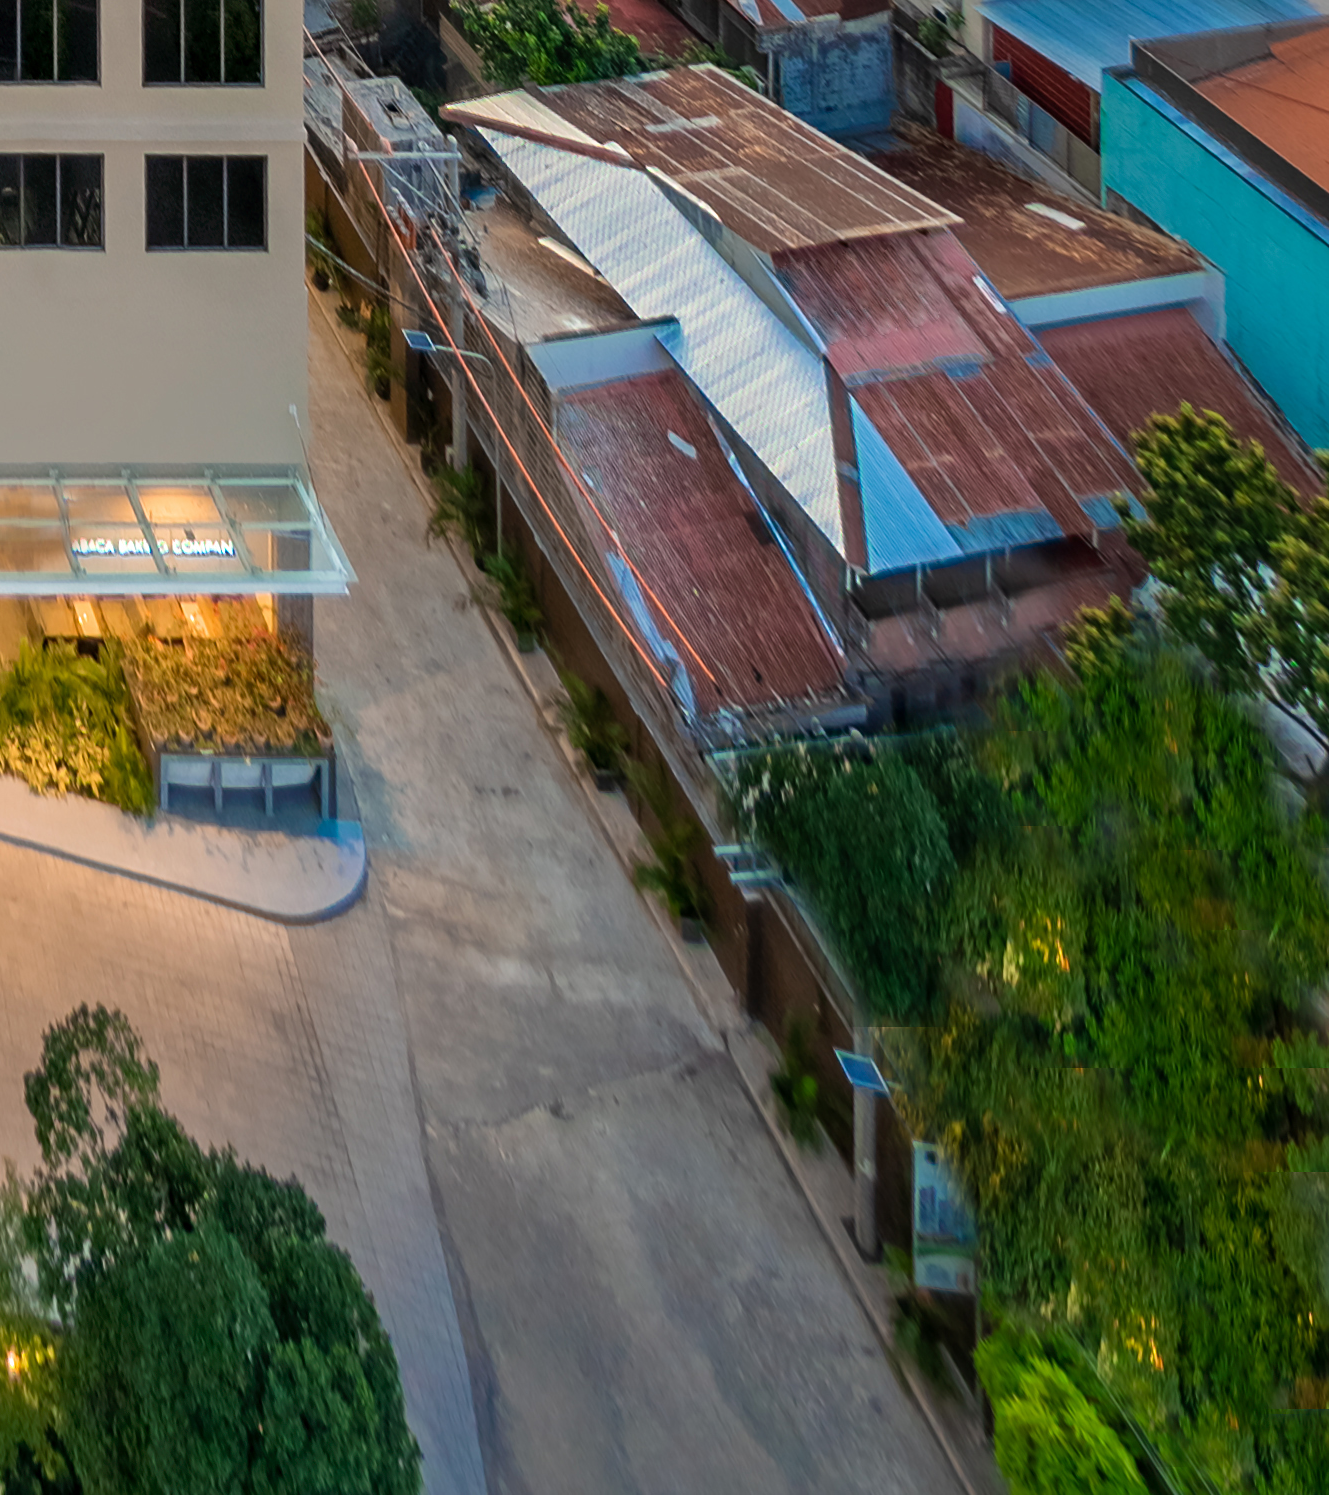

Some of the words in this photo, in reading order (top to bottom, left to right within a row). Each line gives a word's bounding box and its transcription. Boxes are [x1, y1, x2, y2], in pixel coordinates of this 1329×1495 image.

[72, 537, 116, 554] ABACA
[118, 539, 170, 555] BAKIG
[172, 539, 235, 556] COMPAN
